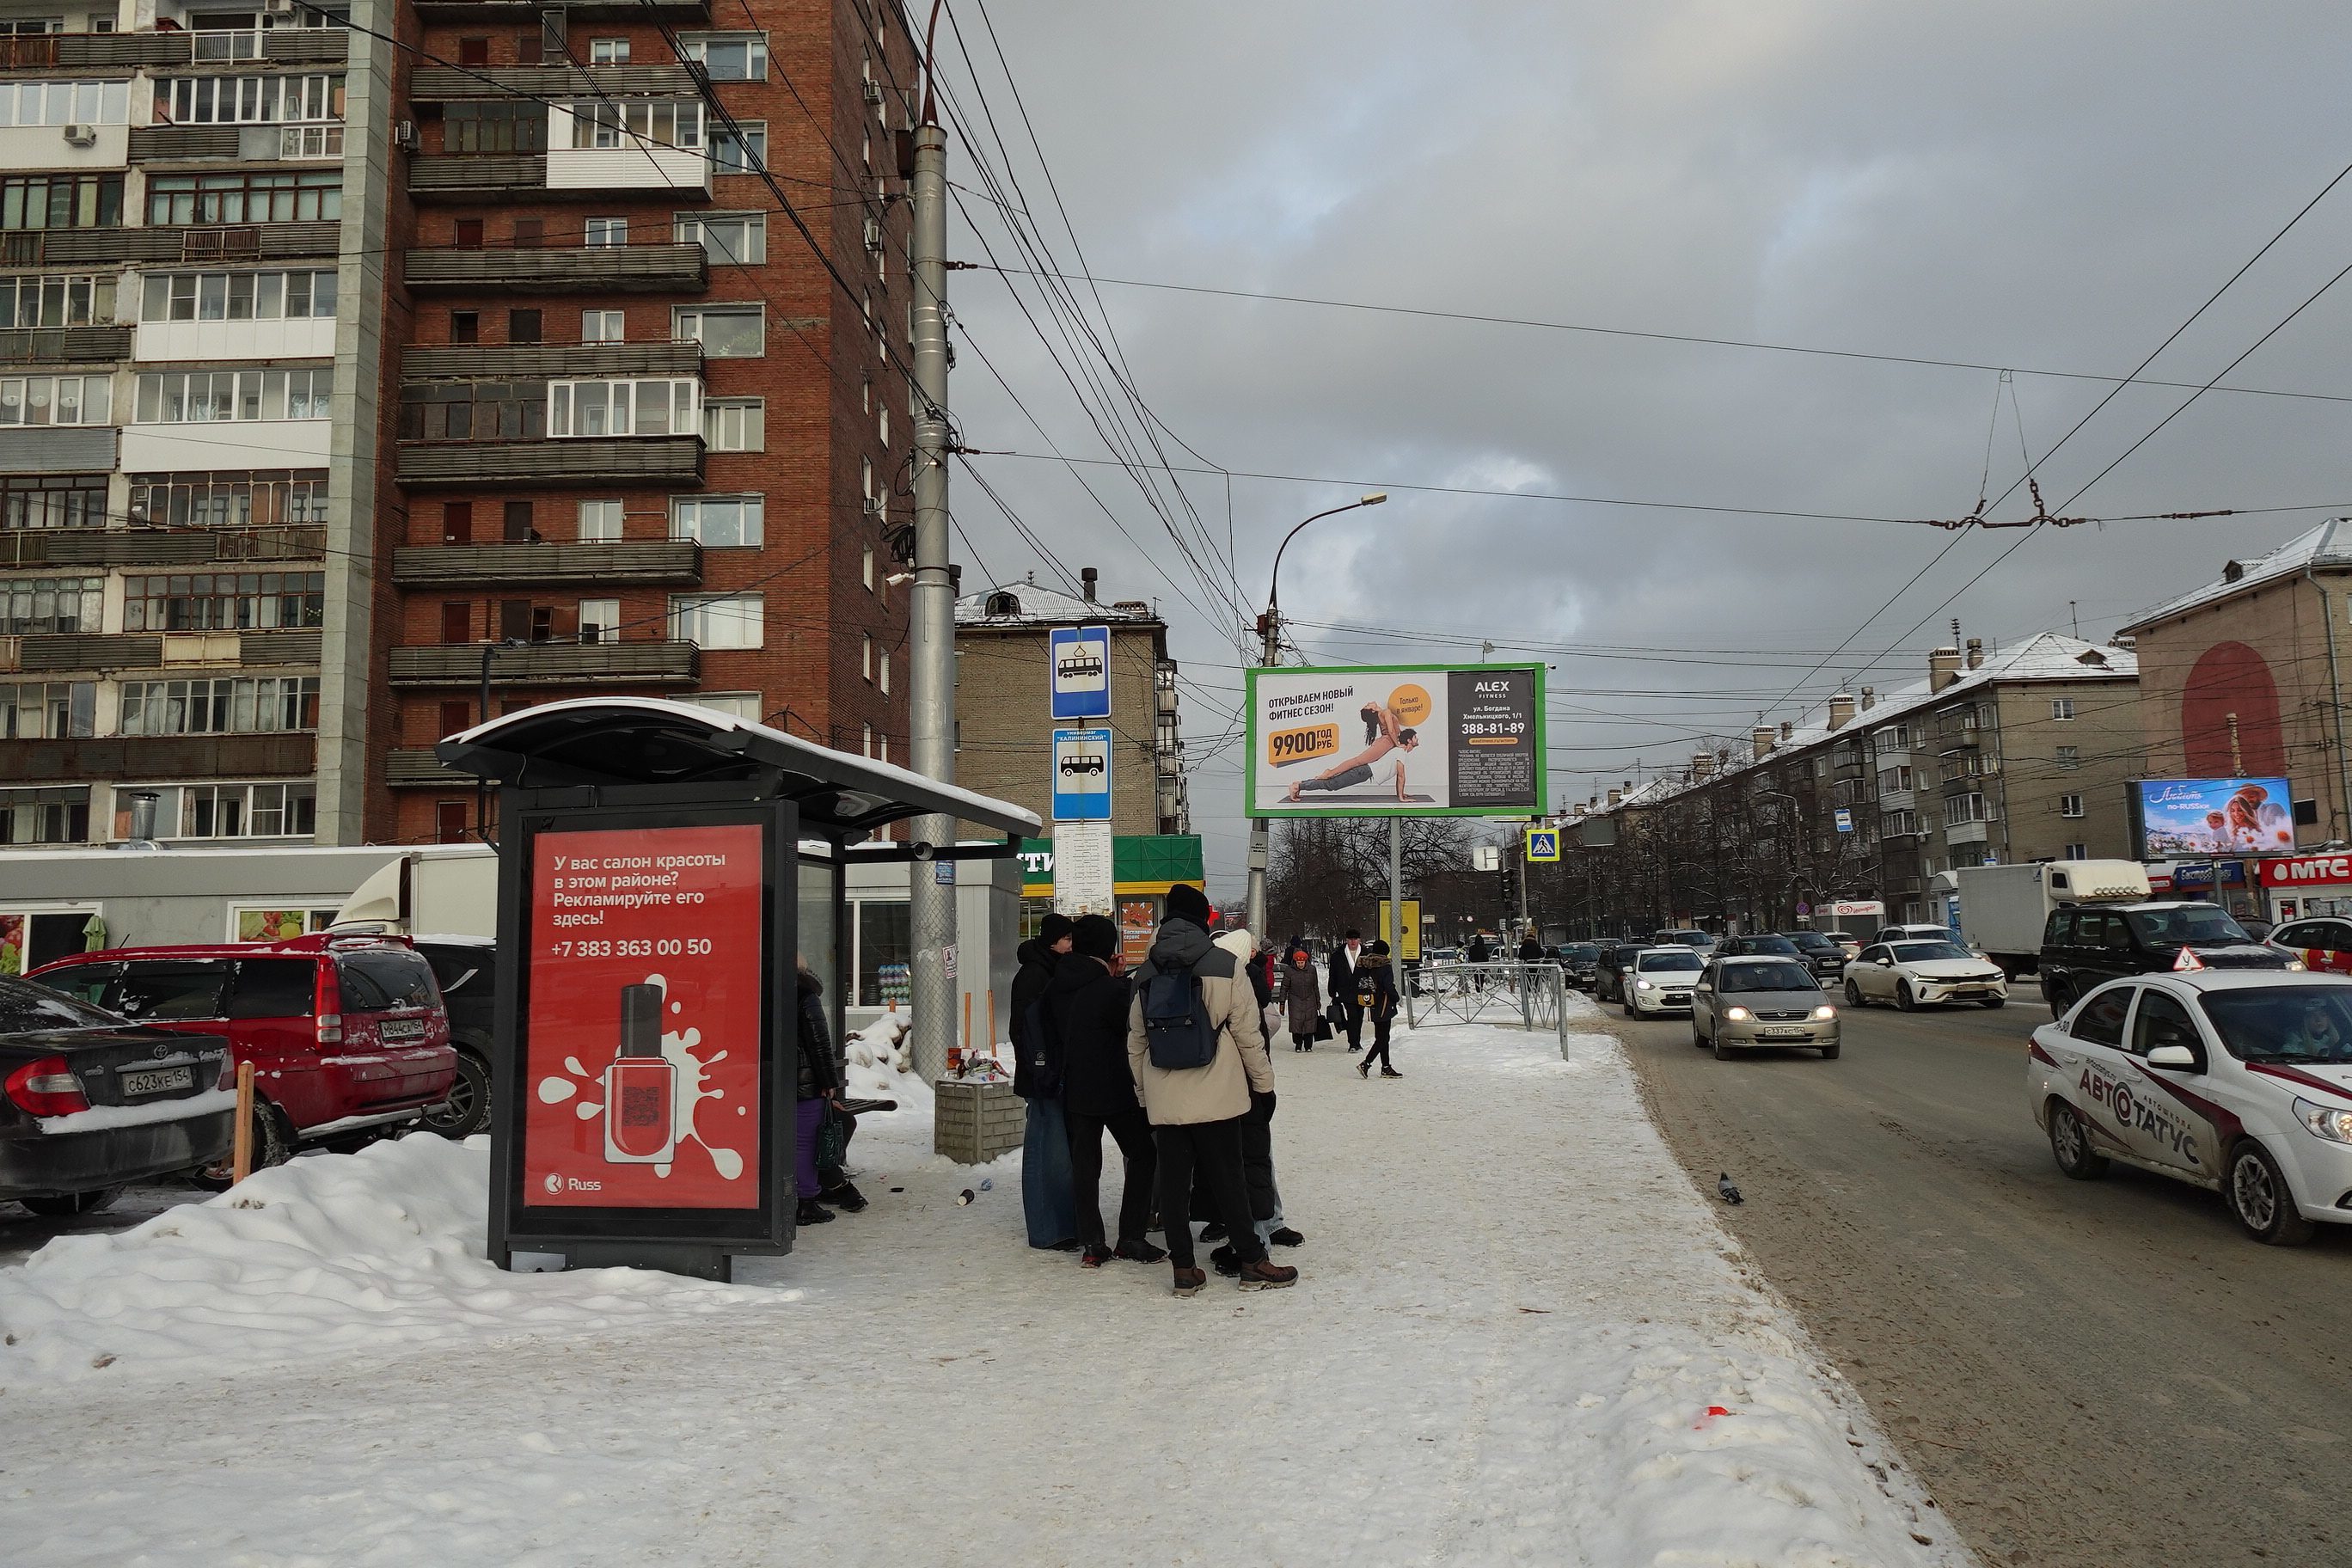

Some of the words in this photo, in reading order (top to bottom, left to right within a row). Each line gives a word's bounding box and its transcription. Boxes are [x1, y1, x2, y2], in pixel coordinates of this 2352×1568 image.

[1474, 681, 1510, 692] ALEX
[1269, 692, 1321, 709] ОТКРЫВАЕМ
[1322, 685, 1354, 700] НОВЫЙ
[1399, 695, 1419, 705] Только
[1269, 706, 1303, 721] ФИТНЕС
[1304, 703, 1334, 716] СЕЗОН!
[1401, 703, 1424, 714] январе!
[1461, 722, 1525, 734] 388-81-89
[1273, 732, 1316, 756] 9900
[1316, 728, 1332, 739] ГОД
[1317, 739, 1334, 750] РУБ.
[554, 855, 567, 870] У
[571, 858, 598, 870] вас
[603, 856, 652, 869] салон
[656, 854, 726, 871] красоты
[2291, 859, 2350, 879] МТС
[554, 878, 563, 889] в
[568, 877, 606, 888] этом
[611, 871, 679, 890] районе?
[553, 891, 671, 909] Рекламируйте
[676, 892, 705, 904] его
[552, 910, 604, 928] здесь!
[551, 941, 573, 958] +7
[576, 940, 611, 957] 383
[616, 940, 652, 956] 363
[657, 939, 682, 955] 00
[687, 938, 713, 955] 50
[568, 1177, 602, 1191] Russ
